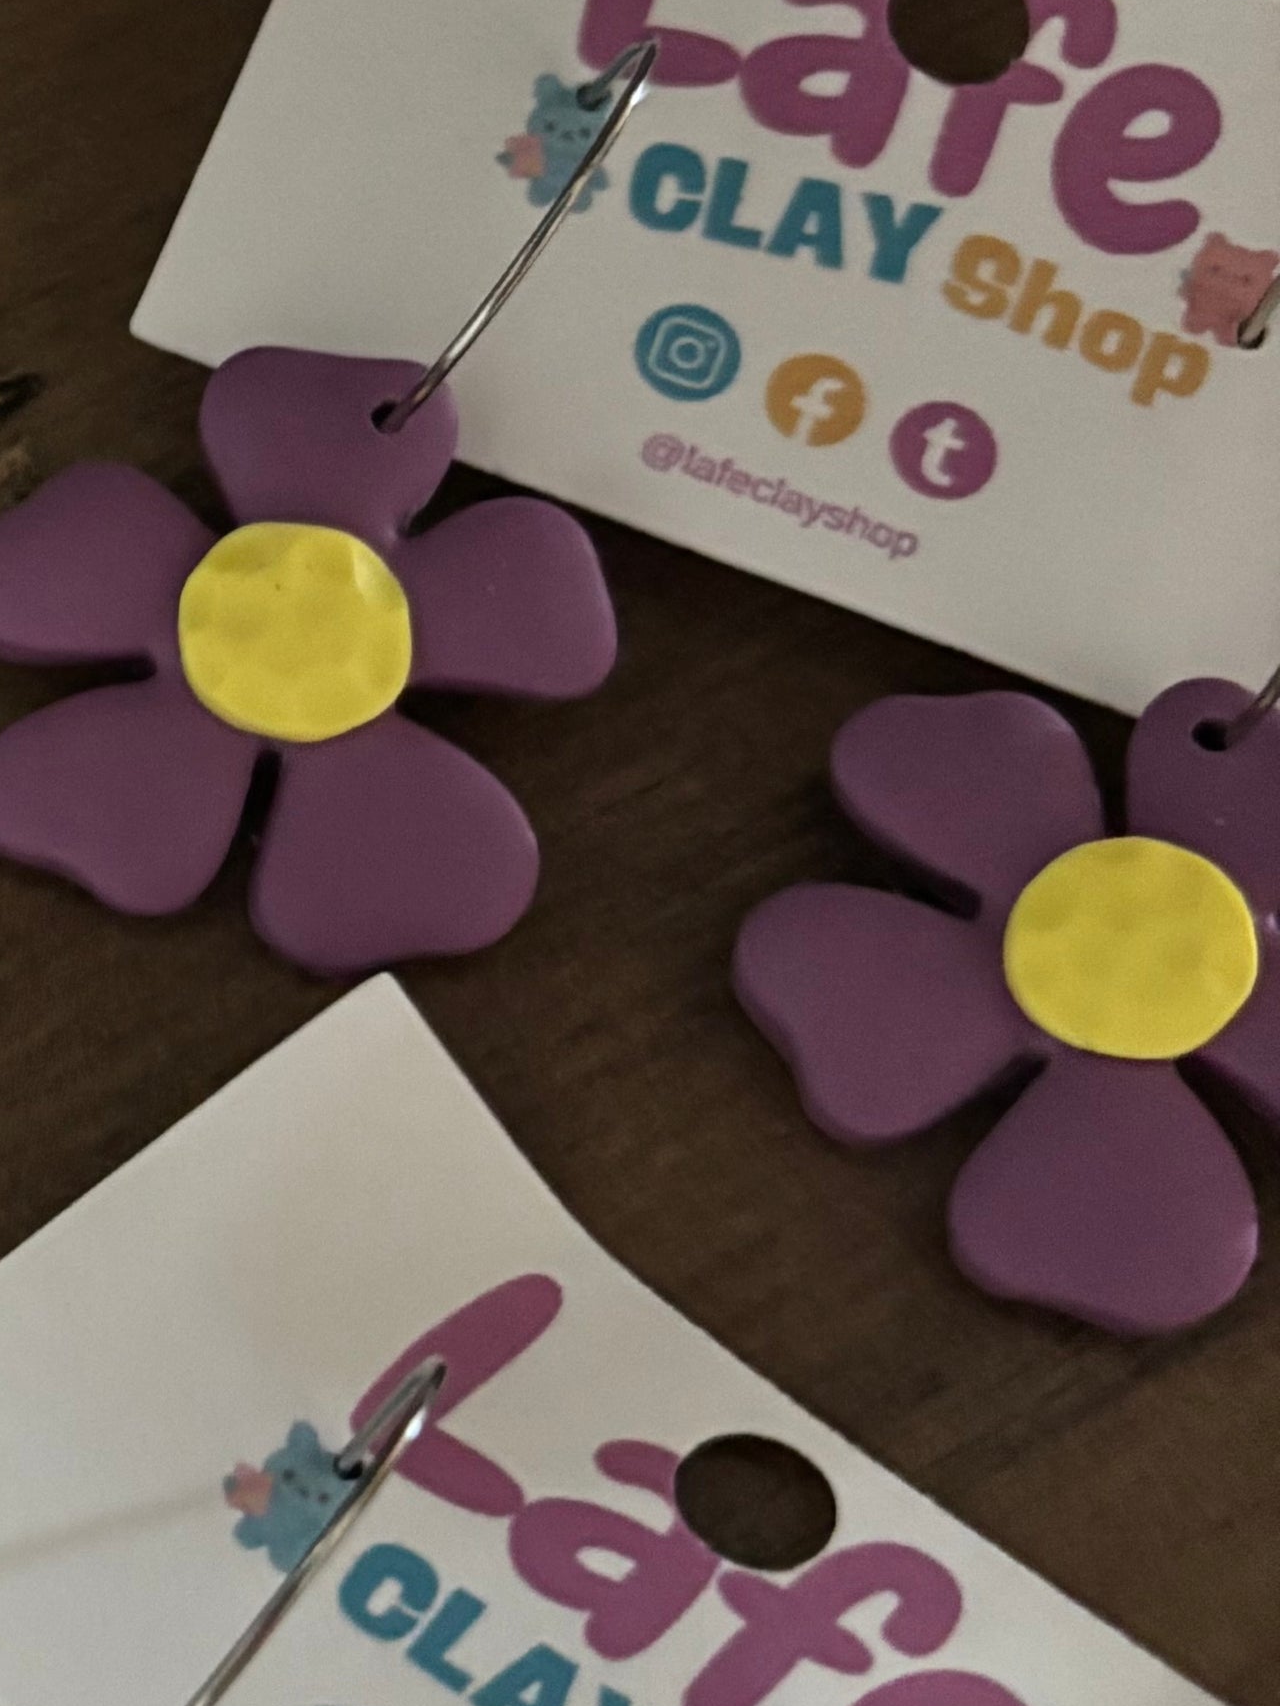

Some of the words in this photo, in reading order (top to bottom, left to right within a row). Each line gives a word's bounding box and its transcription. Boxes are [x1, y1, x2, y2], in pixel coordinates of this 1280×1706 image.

[628, 142, 945, 284] CLAY
[943, 234, 1211, 407] Shop
[641, 434, 919, 560] @lafeclayshop
